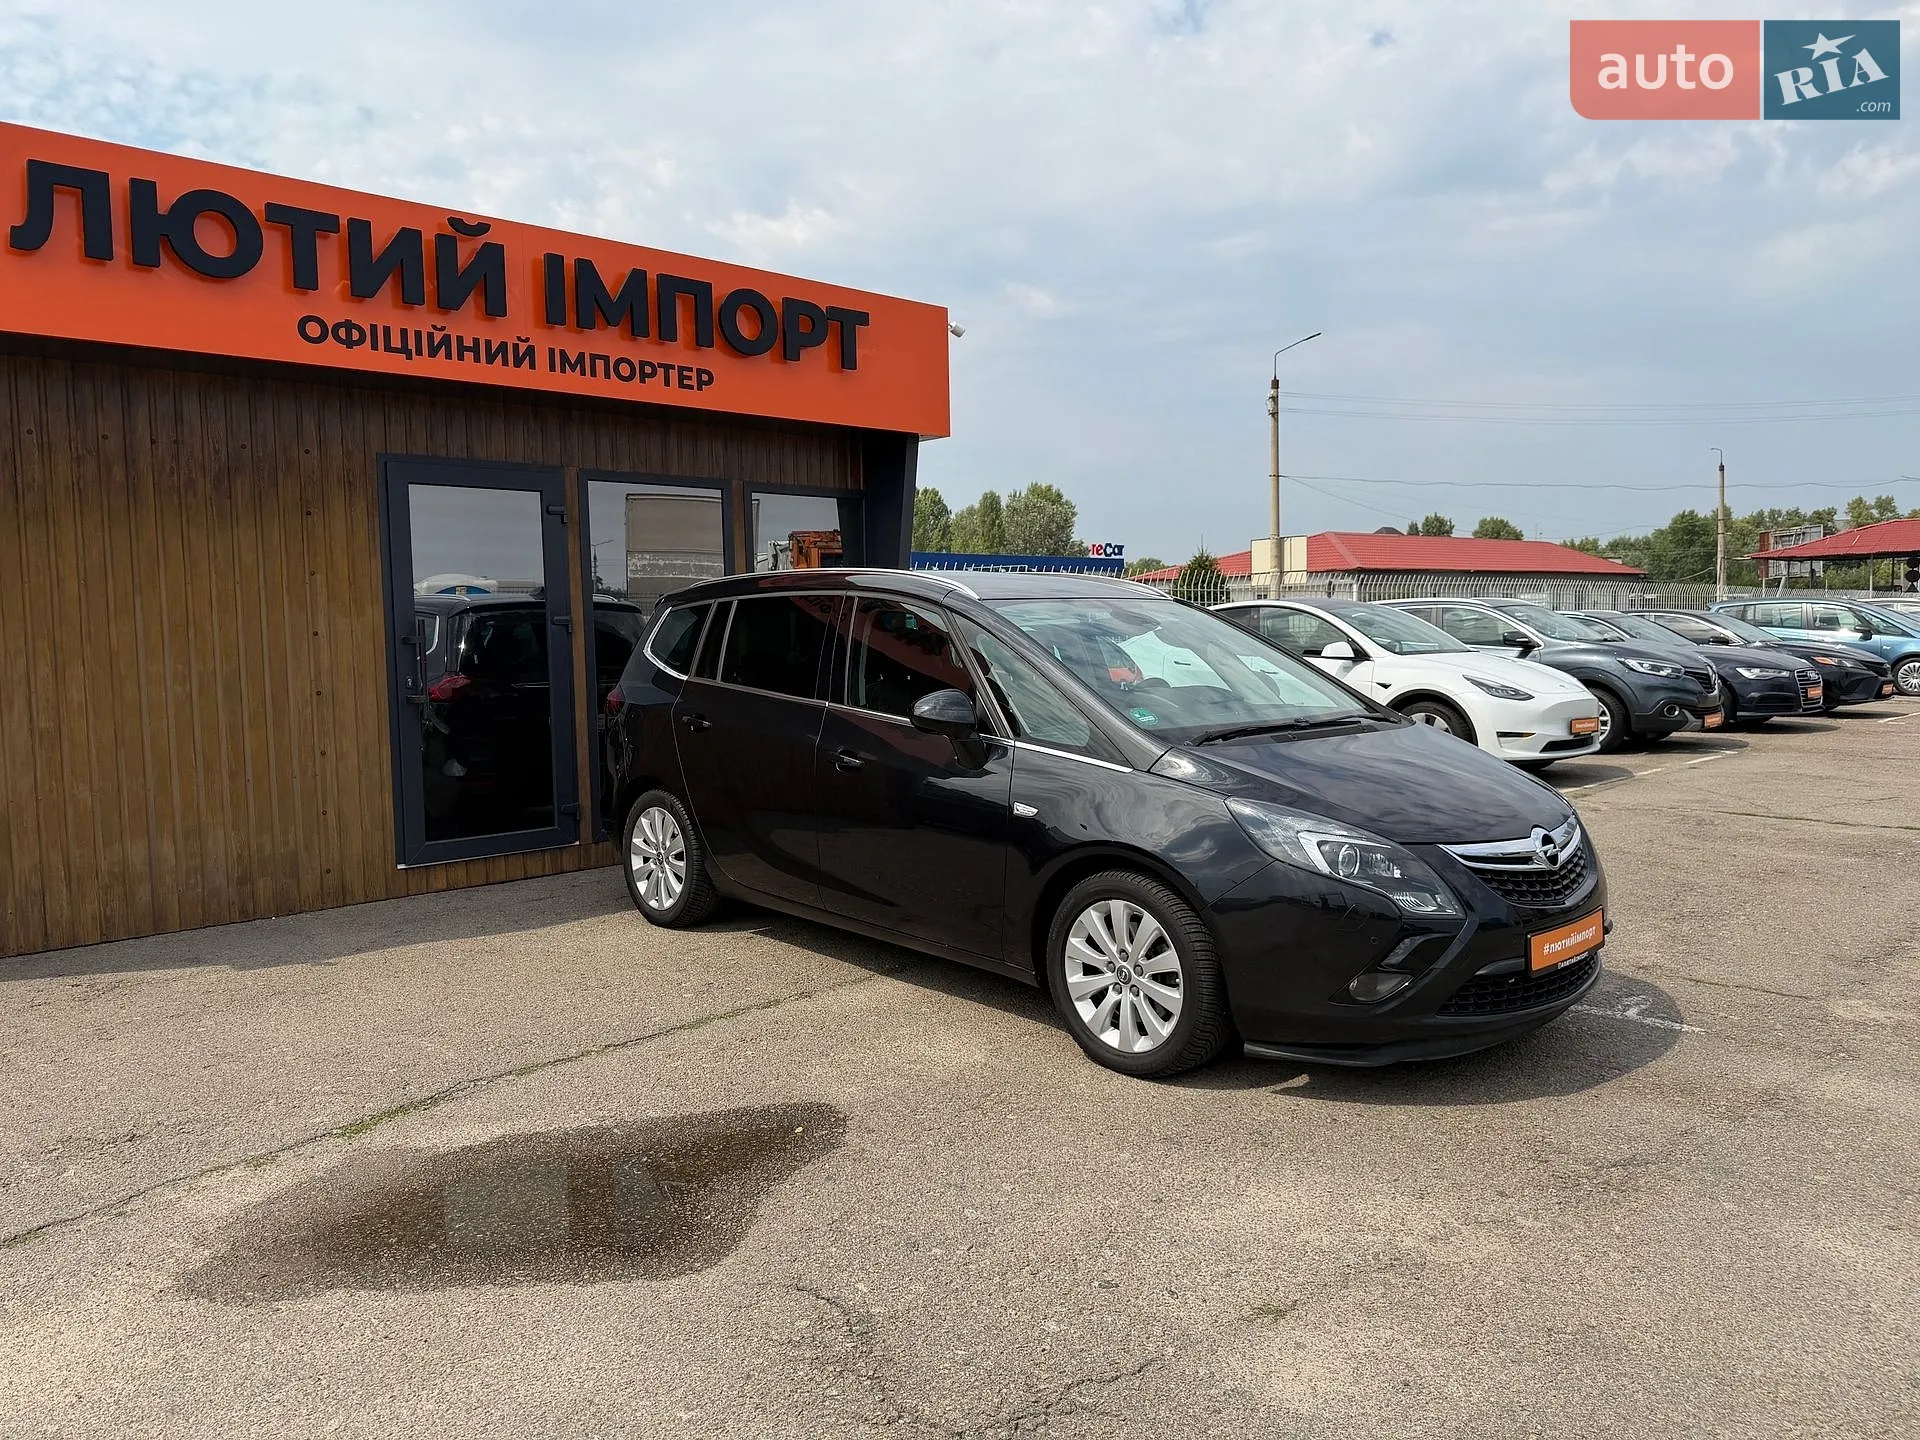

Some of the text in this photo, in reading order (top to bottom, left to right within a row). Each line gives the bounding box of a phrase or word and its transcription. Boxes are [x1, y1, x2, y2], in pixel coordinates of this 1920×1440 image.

[9, 158, 870, 371] ЛЮТИЙ ІМПОРТ
[297, 314, 715, 392] ОФІЦІЙНИЙ ІМПОРТЕР
[1543, 926, 1597, 956] #лютийімпорт
